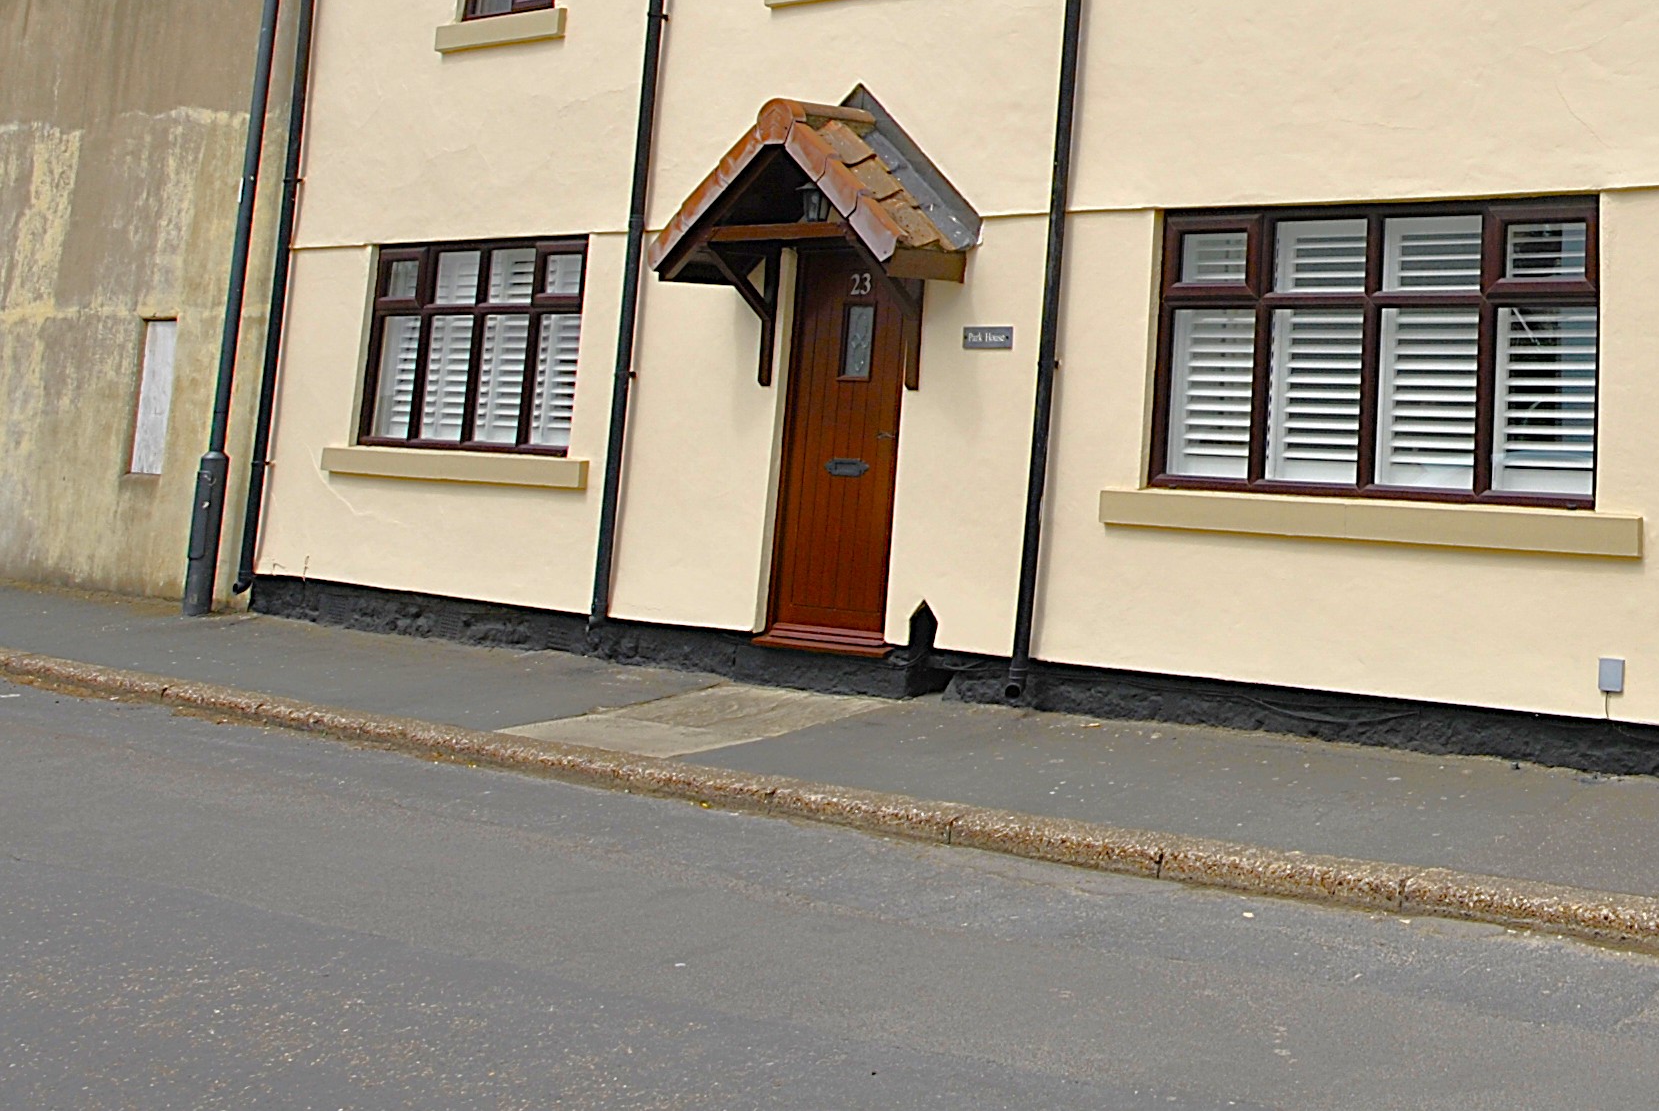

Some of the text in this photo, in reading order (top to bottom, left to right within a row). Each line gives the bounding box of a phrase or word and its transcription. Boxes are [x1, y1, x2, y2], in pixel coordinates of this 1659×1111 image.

[850, 273, 871, 295] 23
[968, 332, 1005, 342] Park House
